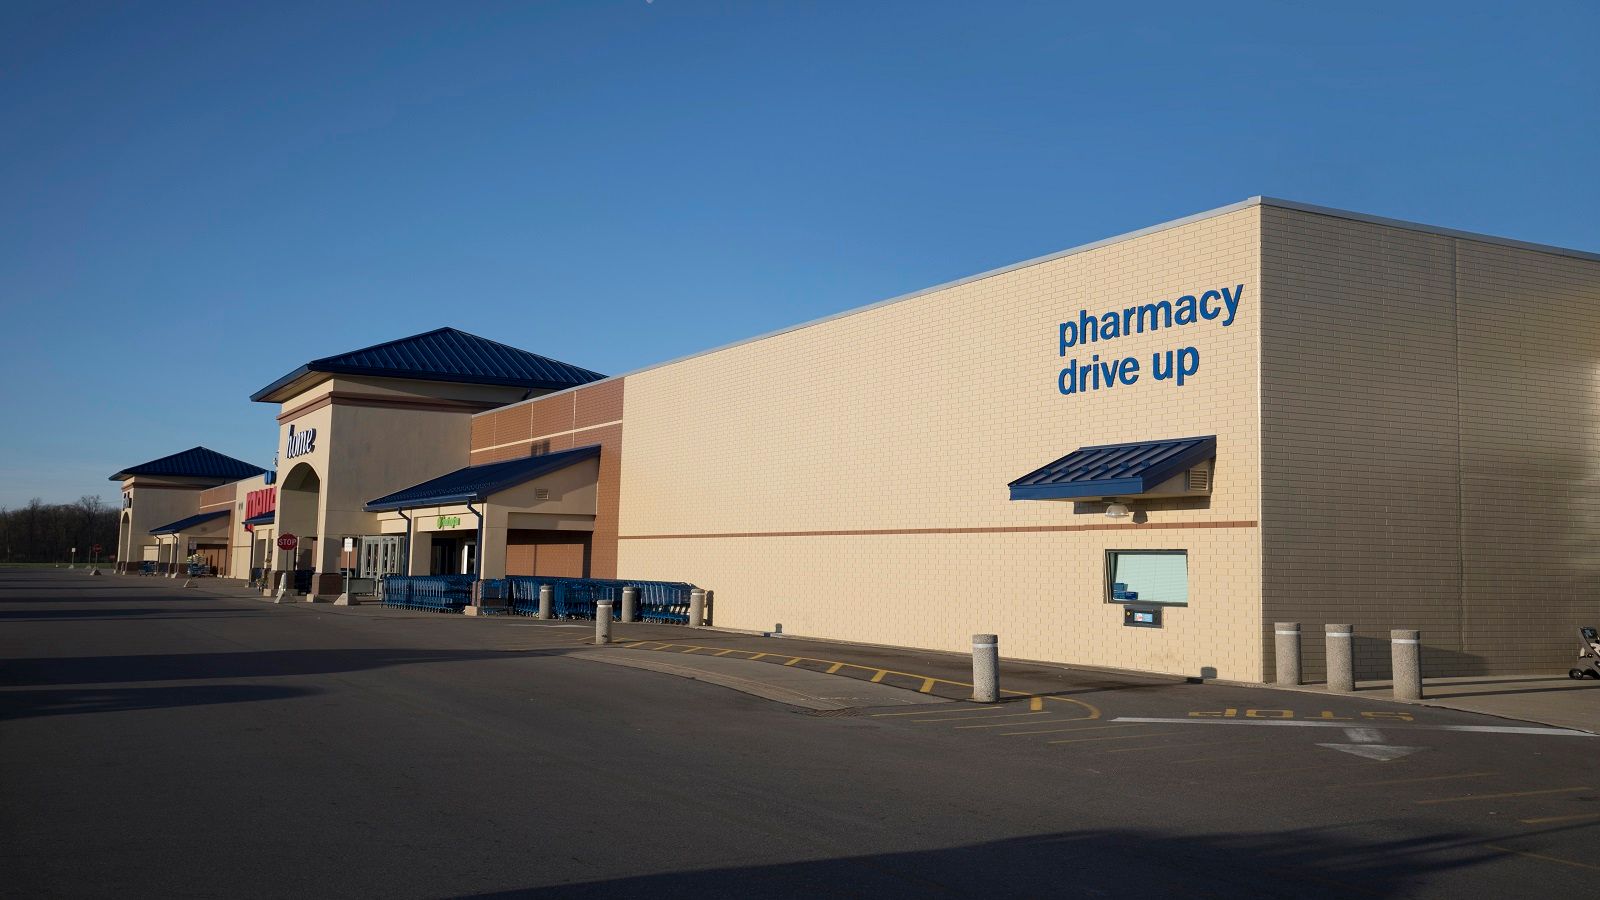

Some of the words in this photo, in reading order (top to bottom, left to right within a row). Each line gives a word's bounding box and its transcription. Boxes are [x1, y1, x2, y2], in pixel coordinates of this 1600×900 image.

[1059, 284, 1244, 357] pharmacy
[1058, 355, 1140, 395] drive
[1152, 346, 1200, 386] up
[286, 424, 316, 459] home
[278, 538, 297, 546] STOP
[1188, 708, 1414, 721] STOP
